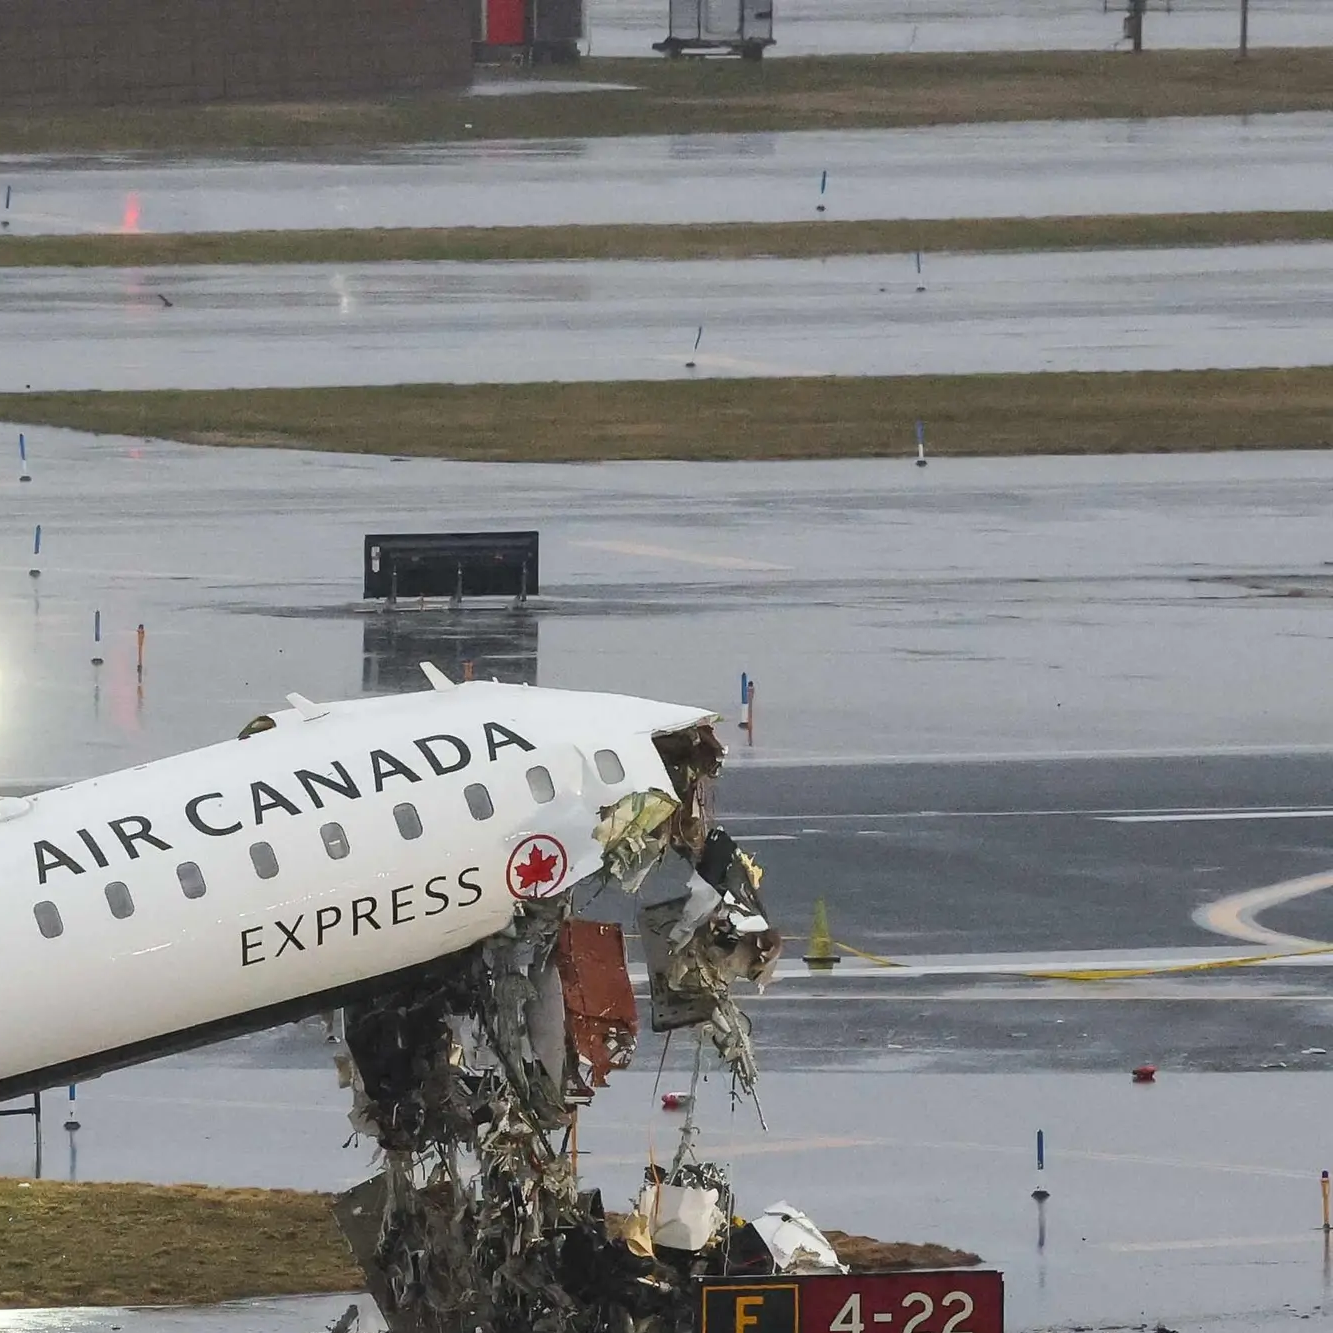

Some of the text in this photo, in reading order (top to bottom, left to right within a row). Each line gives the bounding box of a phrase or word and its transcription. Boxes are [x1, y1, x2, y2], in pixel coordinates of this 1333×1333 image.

[33, 721, 537, 884] AIR CANADA
[241, 866, 484, 967] EXPRESS
